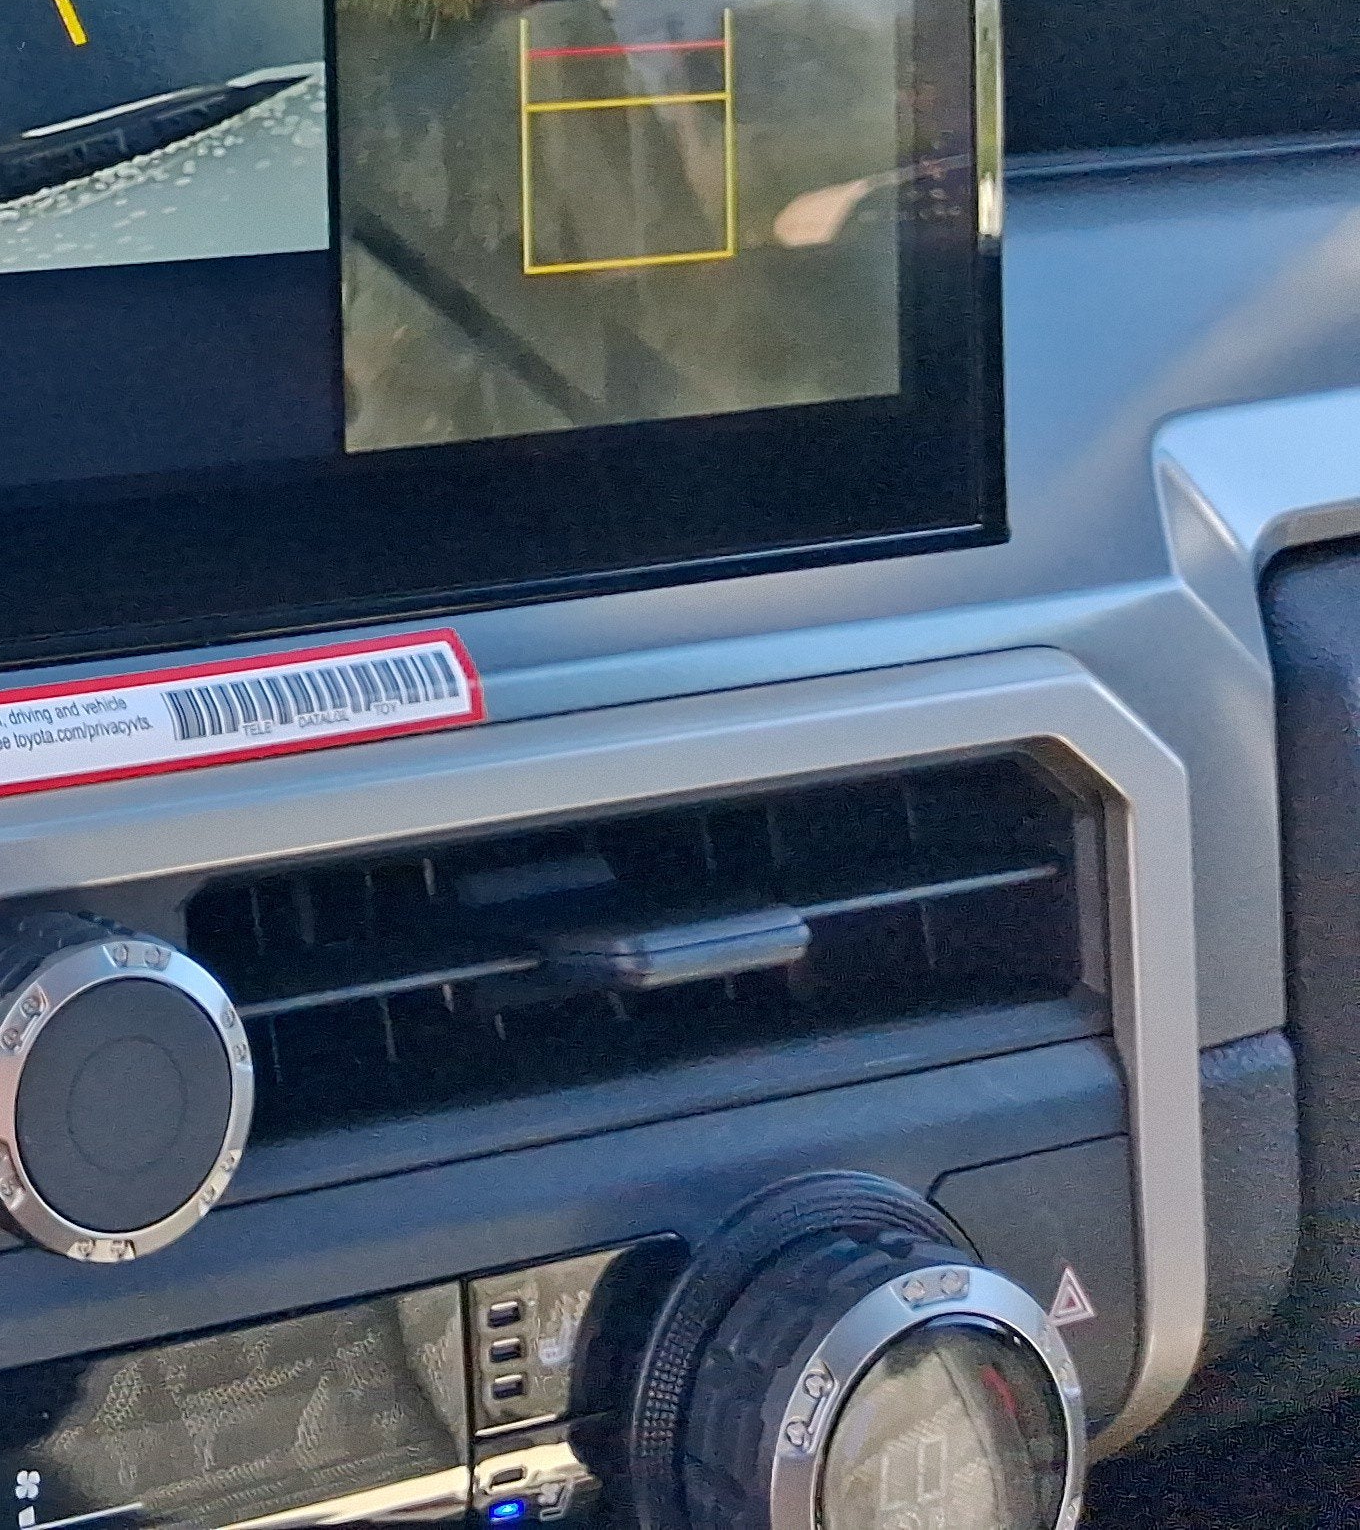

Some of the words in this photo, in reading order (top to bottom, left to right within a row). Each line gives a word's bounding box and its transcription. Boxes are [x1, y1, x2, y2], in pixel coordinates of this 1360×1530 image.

[9, 706, 54, 726] driving
[56, 702, 80, 719] and
[82, 696, 128, 715] vehicle
